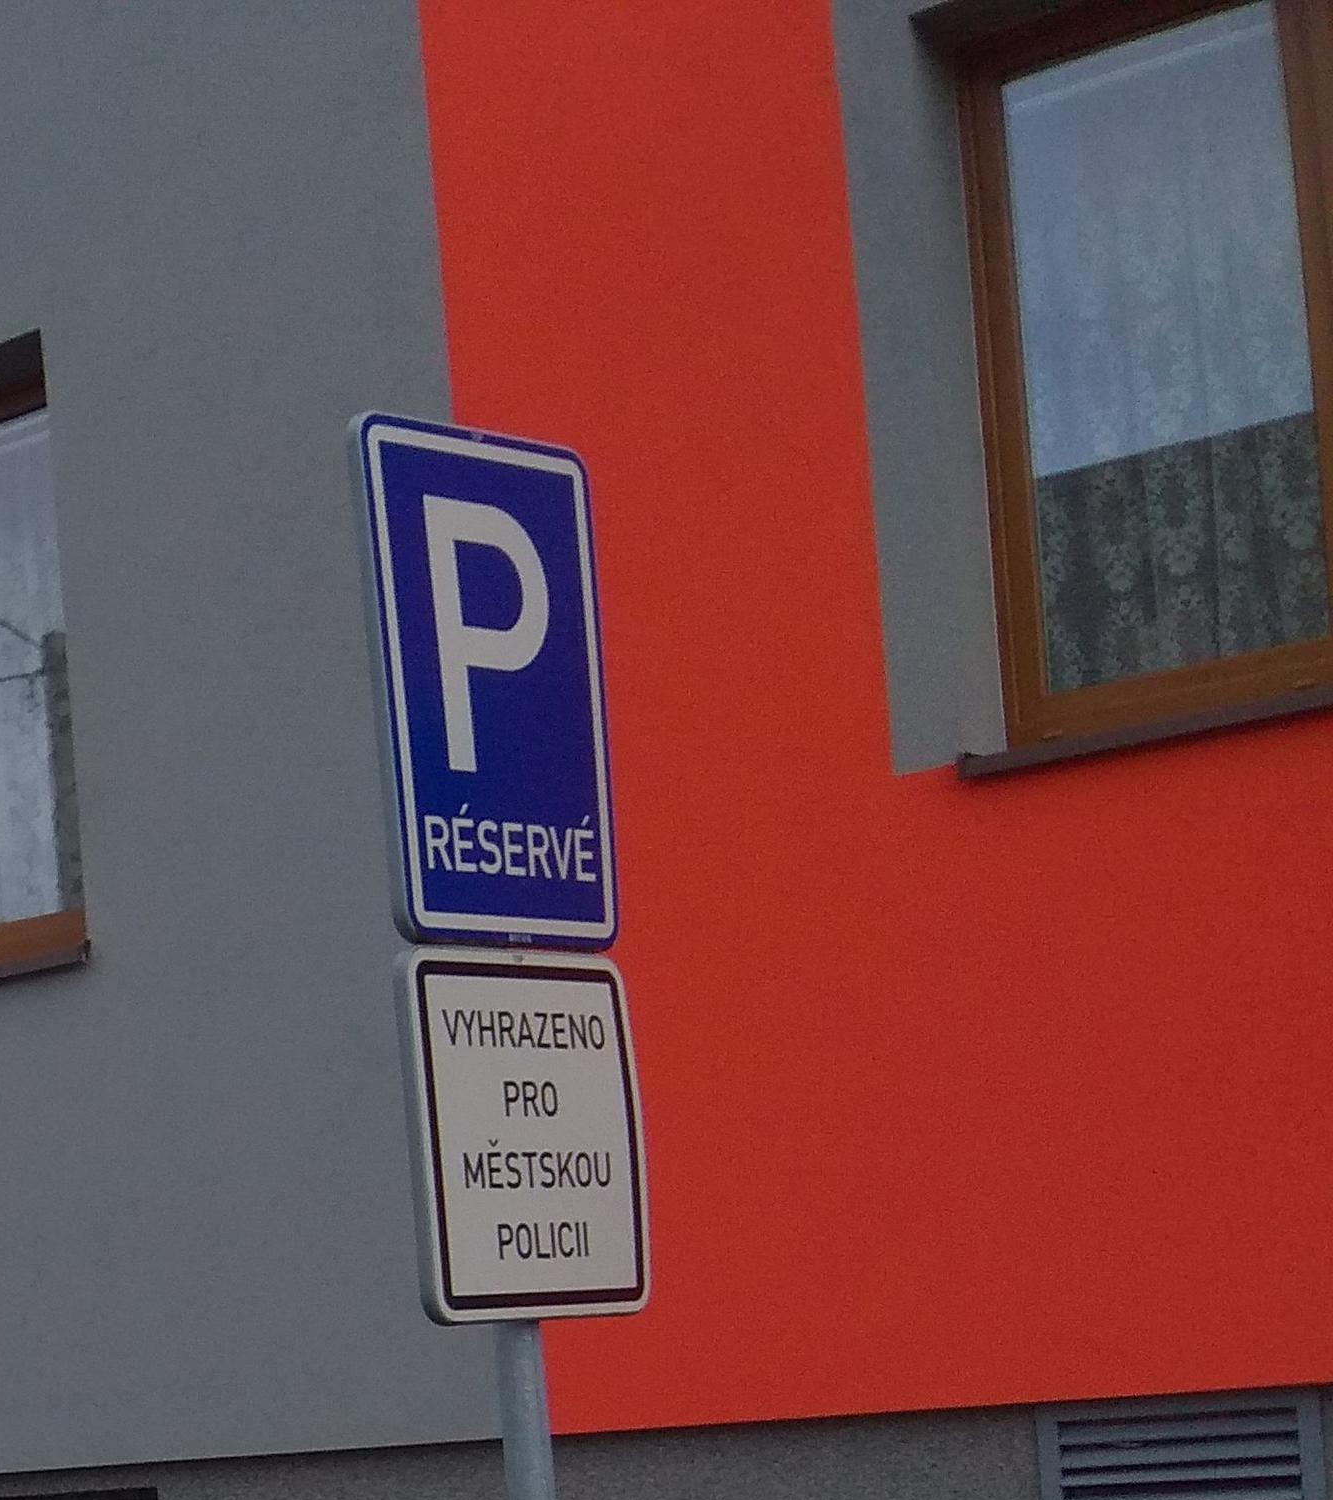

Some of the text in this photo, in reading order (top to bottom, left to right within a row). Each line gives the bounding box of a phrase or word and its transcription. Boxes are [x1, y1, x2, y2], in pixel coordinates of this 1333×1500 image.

[423, 494, 549, 772] P
[424, 804, 596, 883] RÉSERVÉ
[442, 1009, 605, 1051] VYHRAZENO
[503, 1080, 559, 1118] PRO
[463, 1139, 611, 1190] MĚSTSKOU
[497, 1222, 589, 1260] POLICII
